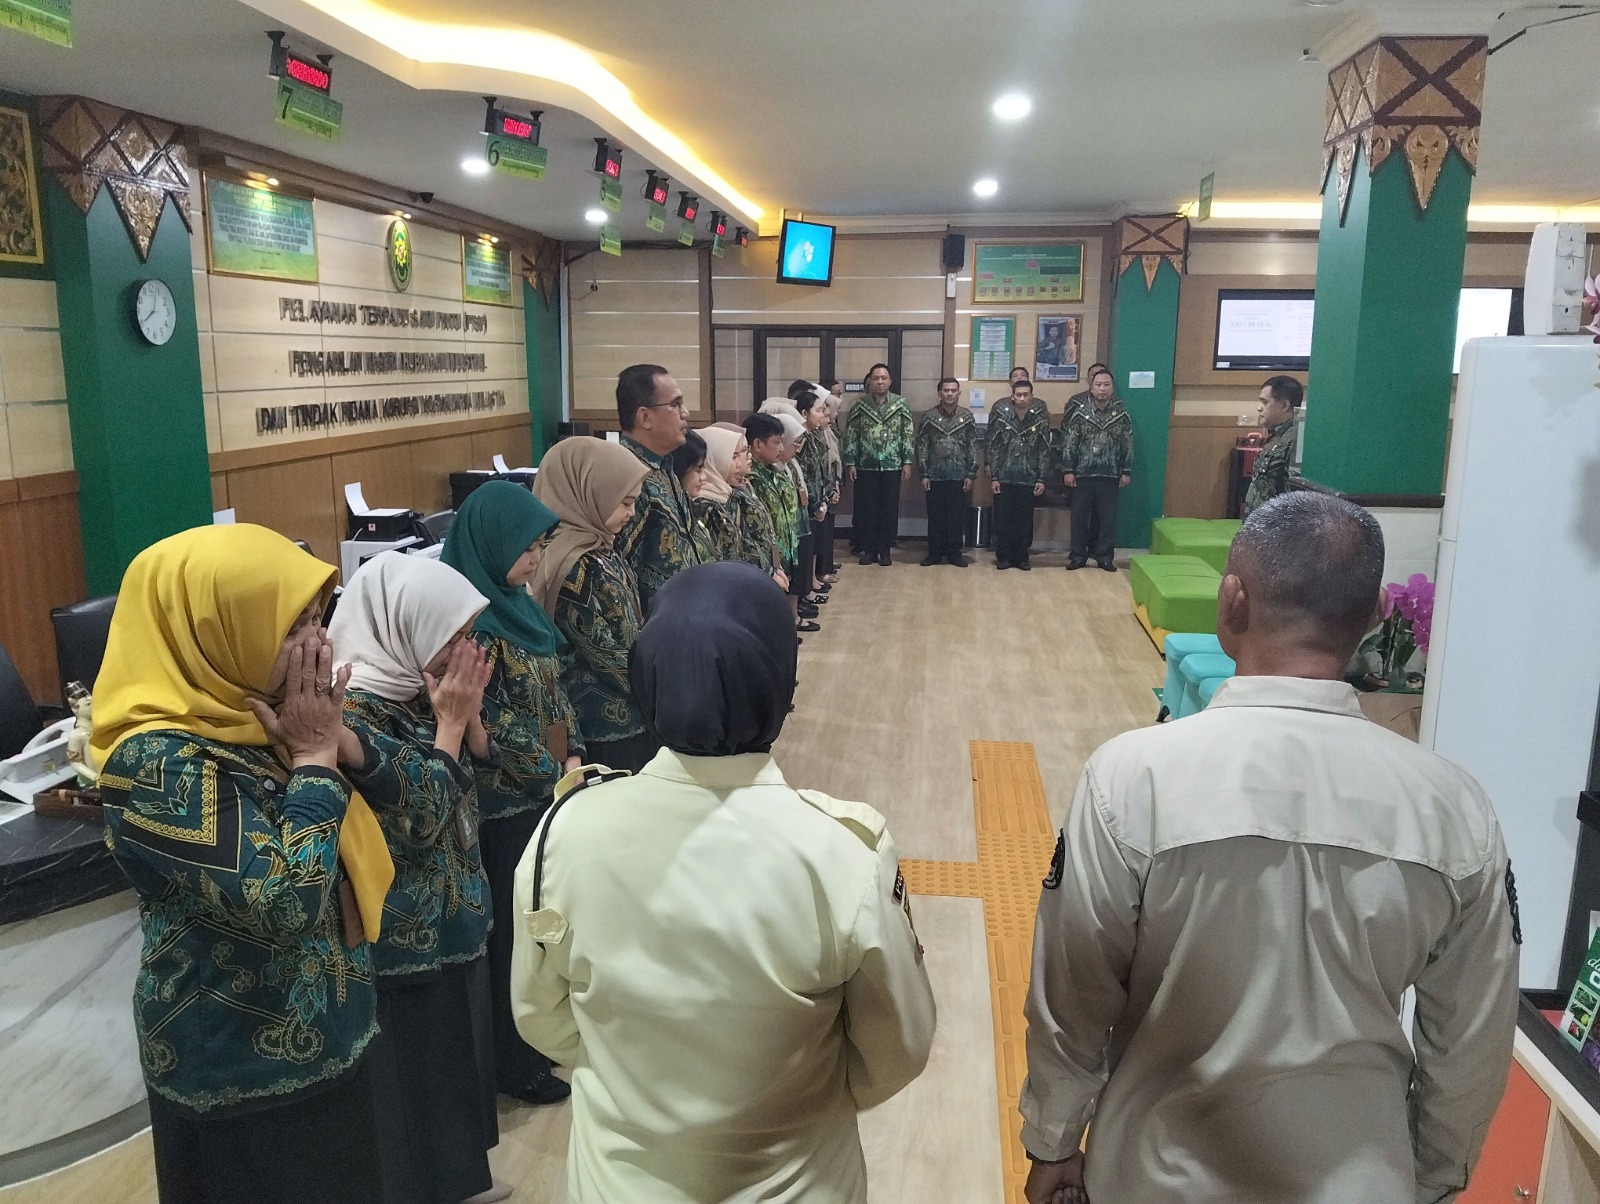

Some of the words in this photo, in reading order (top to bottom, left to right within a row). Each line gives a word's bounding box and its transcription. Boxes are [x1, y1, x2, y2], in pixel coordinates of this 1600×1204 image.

[281, 83, 294, 120] 7
[487, 140, 500, 167] 6
[256, 406, 287, 436] DAN
